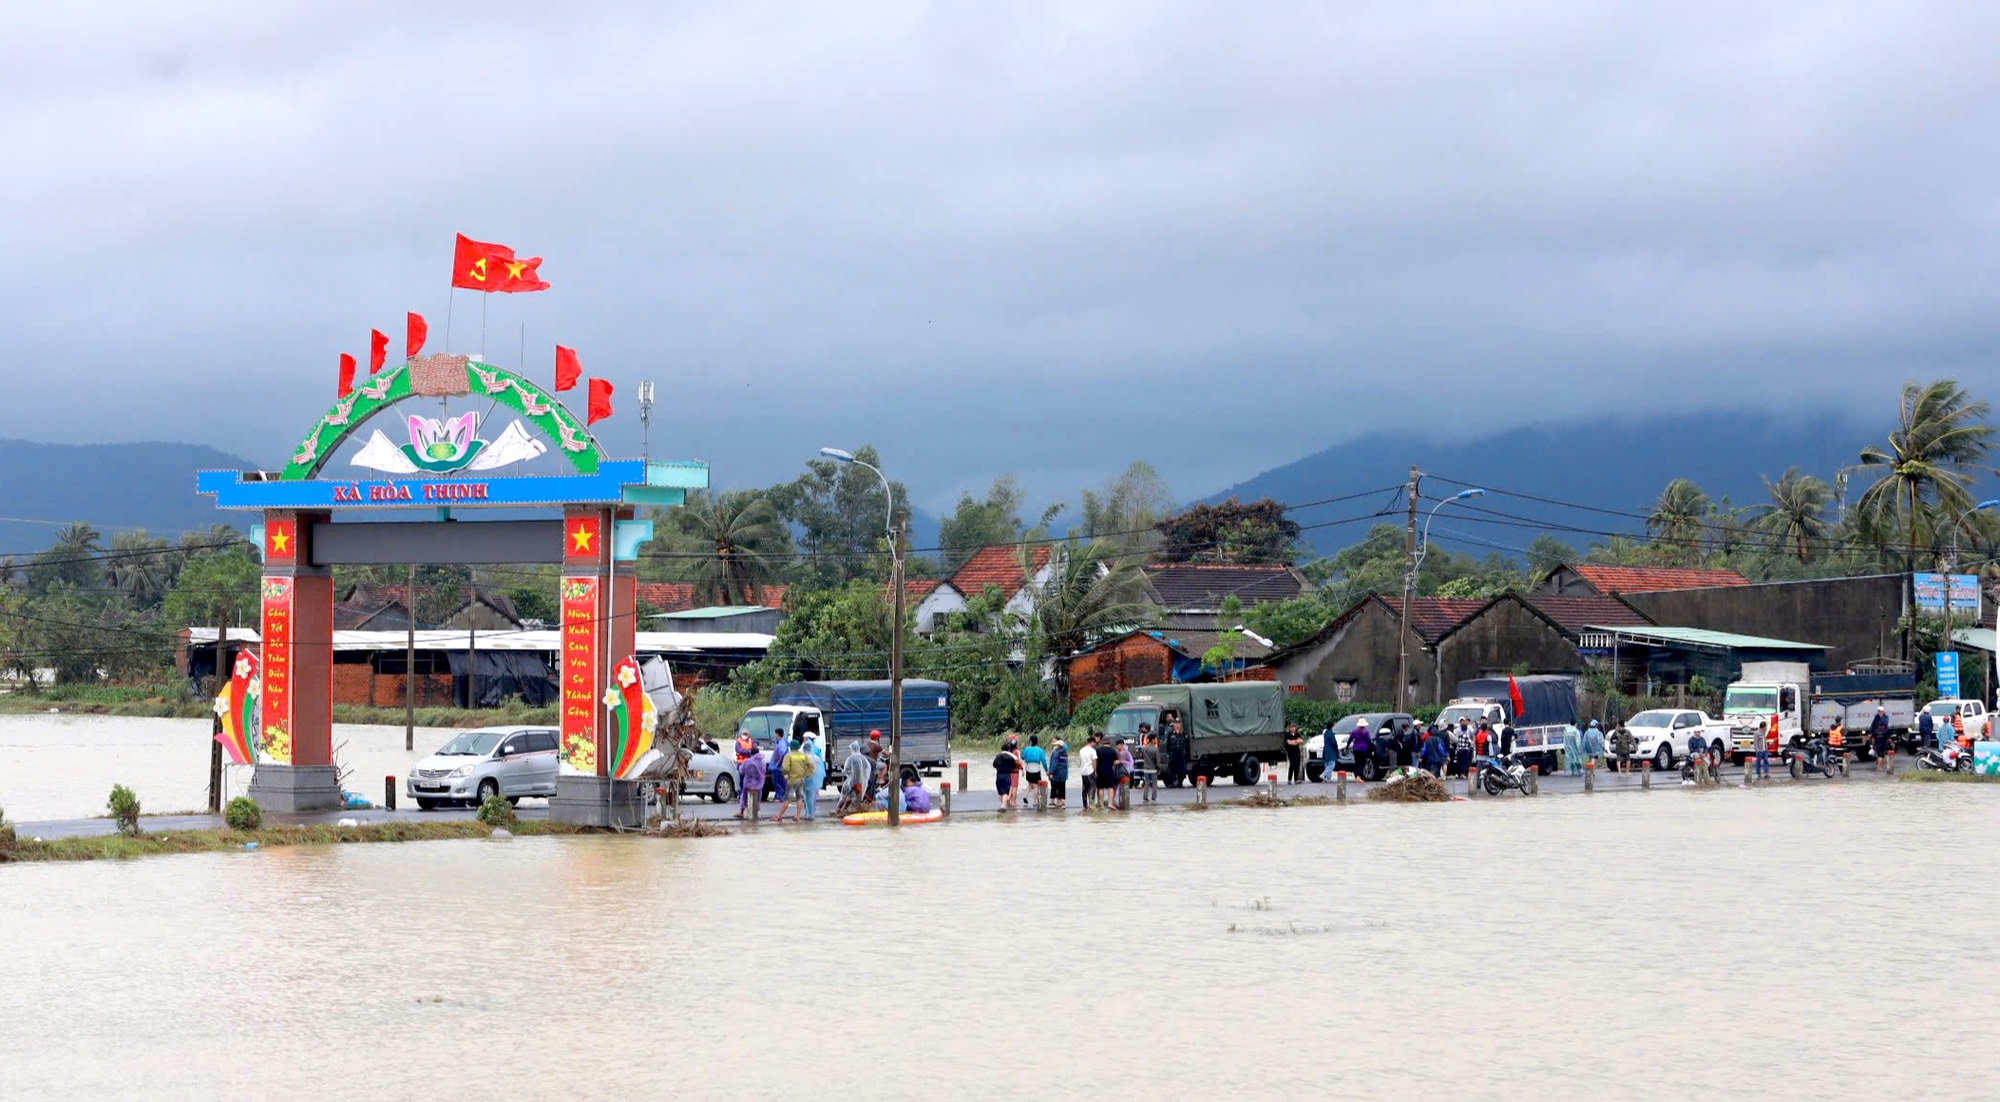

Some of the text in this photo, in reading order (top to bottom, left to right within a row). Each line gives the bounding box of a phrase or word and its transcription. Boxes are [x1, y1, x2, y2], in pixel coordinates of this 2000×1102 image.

[333, 479, 489, 503] XÃ HÒA THỊNH
[267, 607, 287, 617] Chúc
[270, 622, 283, 633] Tết
[565, 608, 592, 719] Mừng Xuân Sang Vạn Sự Thành Công
[267, 683, 284, 694] Như
